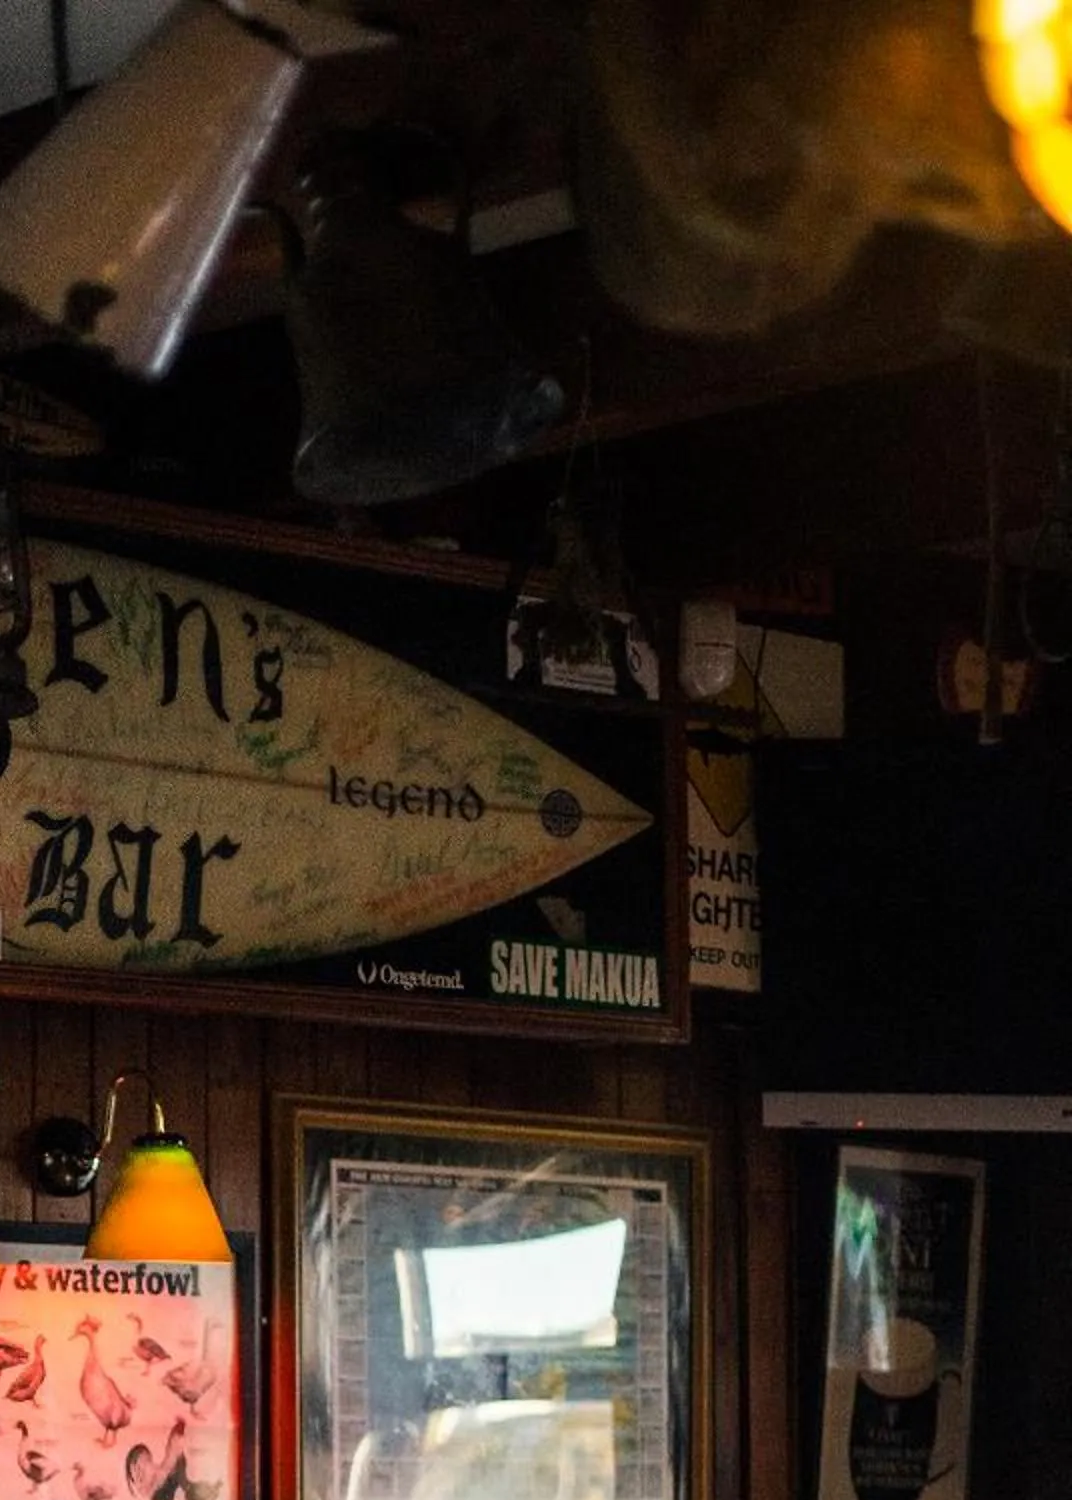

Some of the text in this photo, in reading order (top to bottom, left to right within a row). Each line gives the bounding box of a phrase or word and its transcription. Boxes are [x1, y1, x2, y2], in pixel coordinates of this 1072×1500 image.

[24, 810, 242, 948] Bar
[490, 939, 662, 1009] SAVE MAKUA
[688, 943, 726, 965] KEEP
[14, 1260, 38, 1290] &
[47, 1263, 202, 1298] waterfowl
